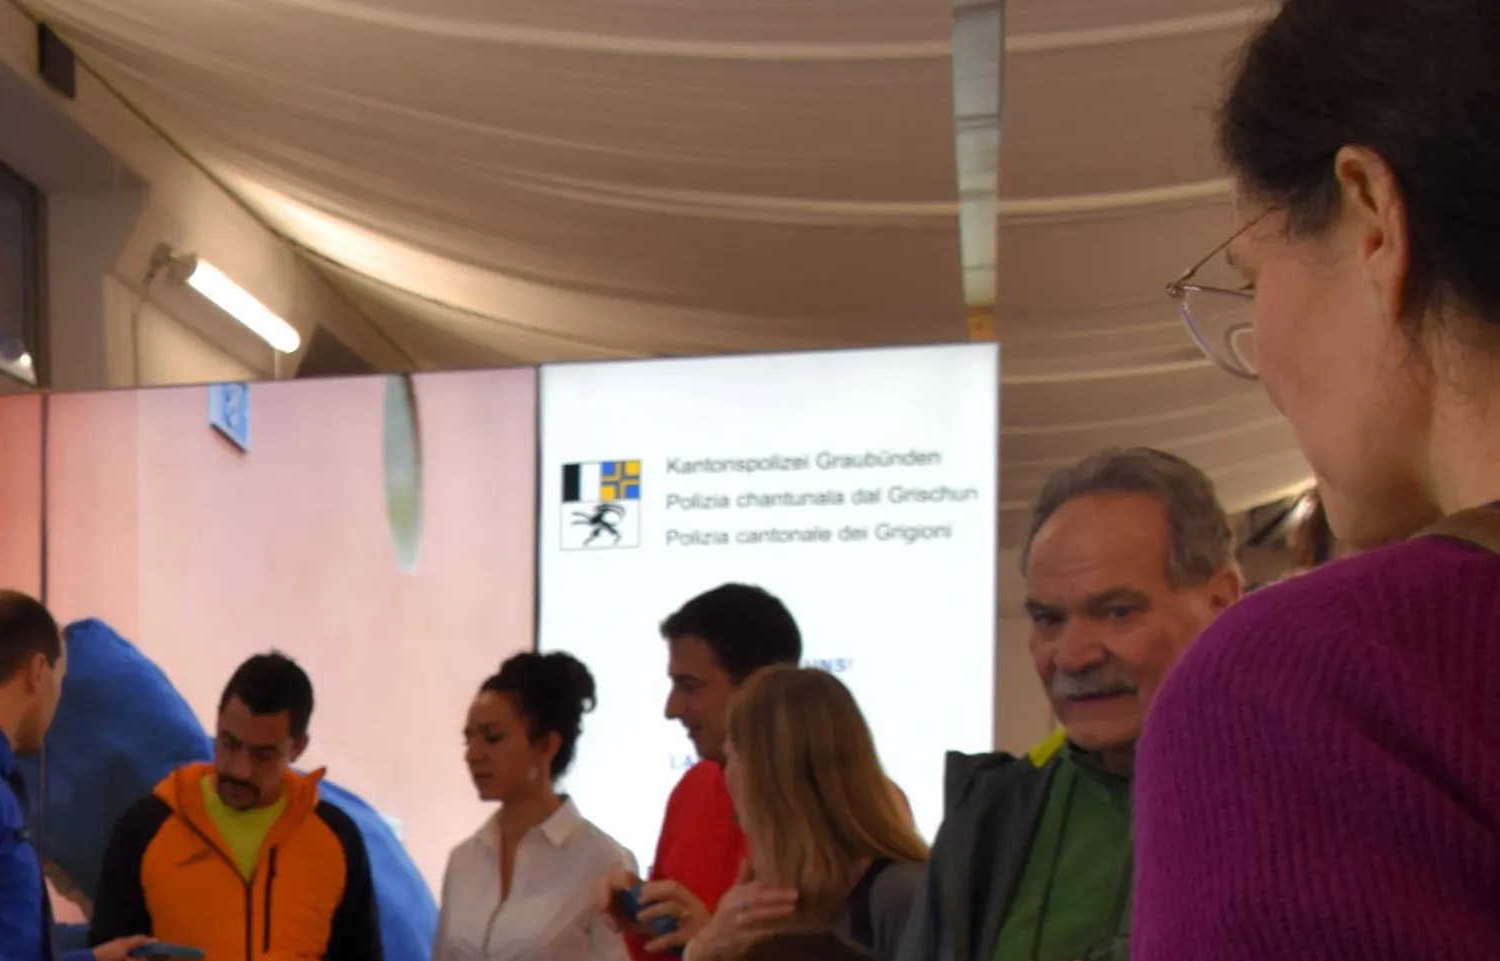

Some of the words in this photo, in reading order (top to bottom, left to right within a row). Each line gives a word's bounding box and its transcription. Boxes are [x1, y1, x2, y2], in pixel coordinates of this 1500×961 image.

[666, 453, 809, 475] Kantonspolizei
[816, 449, 942, 470] Graubünden
[666, 493, 730, 510] Polizia
[736, 489, 845, 508] chantunala
[851, 487, 881, 505] dal
[887, 484, 978, 503] Grischun
[666, 529, 730, 546] Polizia
[735, 525, 832, 545] cantonale
[838, 524, 868, 542] dei
[874, 521, 953, 545] Grigioni
